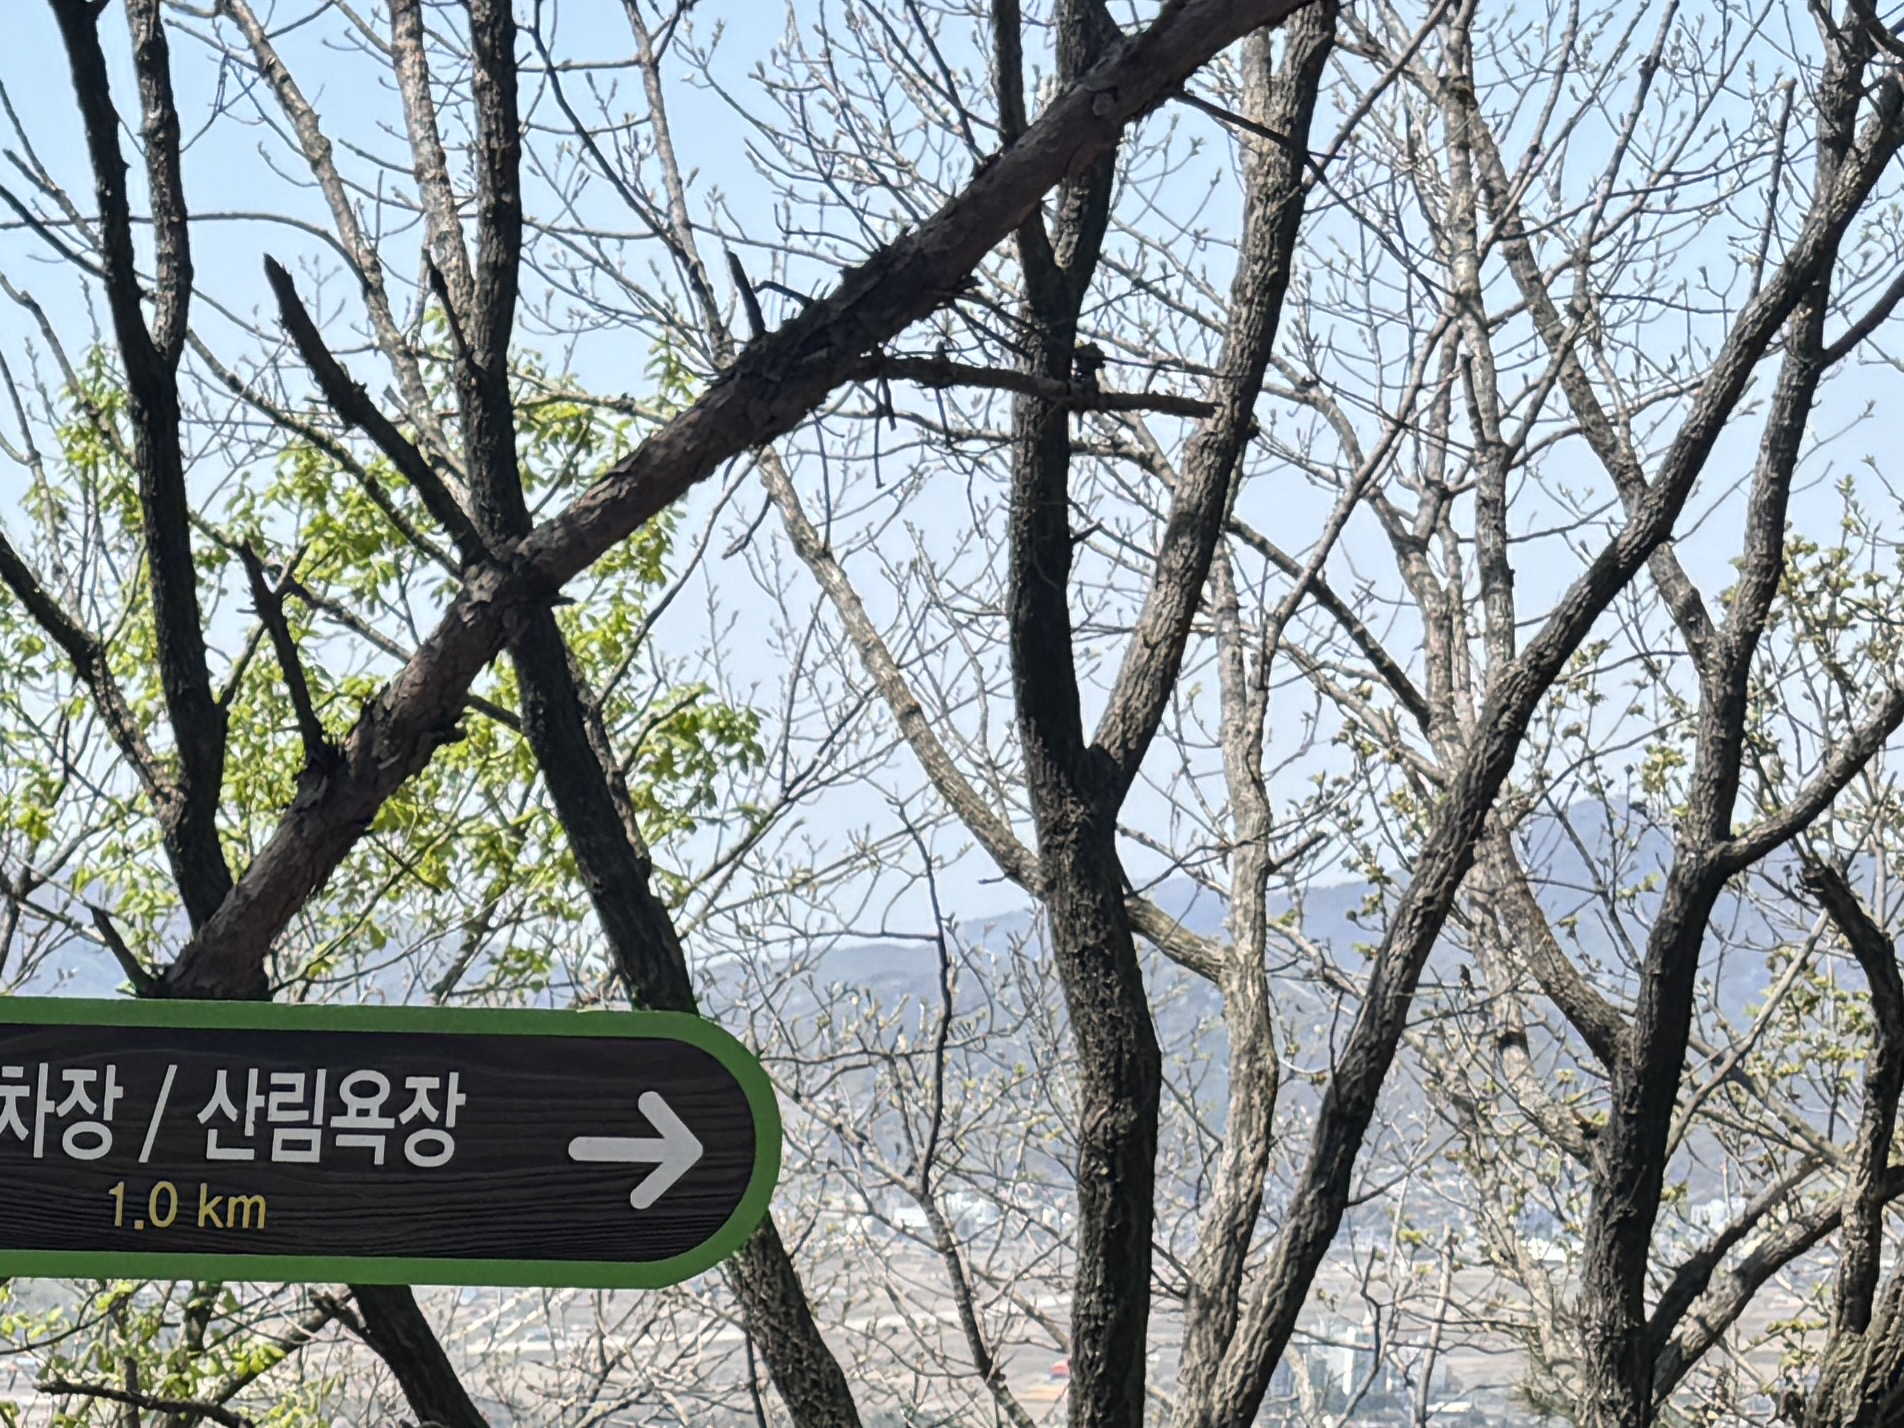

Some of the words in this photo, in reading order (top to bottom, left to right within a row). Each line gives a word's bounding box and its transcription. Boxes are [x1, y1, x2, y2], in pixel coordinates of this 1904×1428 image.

[196, 1067, 467, 1168] 산림욕장
[108, 1180, 179, 1230] 1.0
[197, 1182, 266, 1230] km
